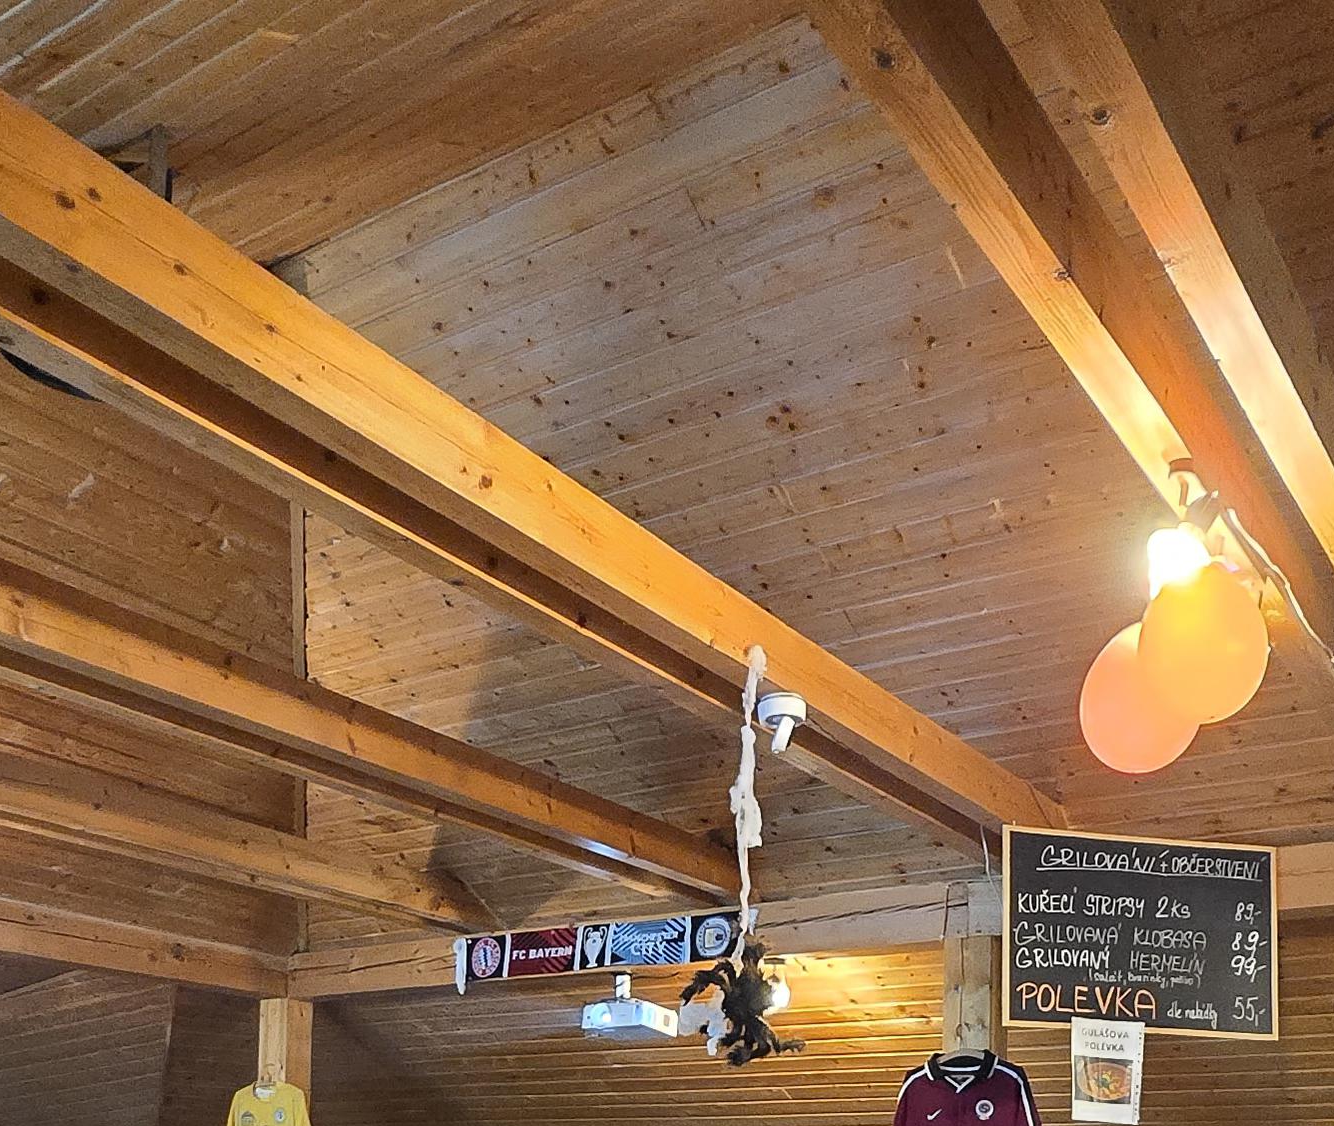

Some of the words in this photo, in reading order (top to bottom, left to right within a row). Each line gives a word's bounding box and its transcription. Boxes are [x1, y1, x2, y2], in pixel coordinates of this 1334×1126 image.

[1017, 887, 1078, 914] KUŘECÍ
[1013, 921, 1122, 946] GRILOVANÁ
[512, 948, 526, 960] FC
[528, 945, 573, 959] BAYERN
[1015, 945, 1110, 969] GRILOVANÝ
